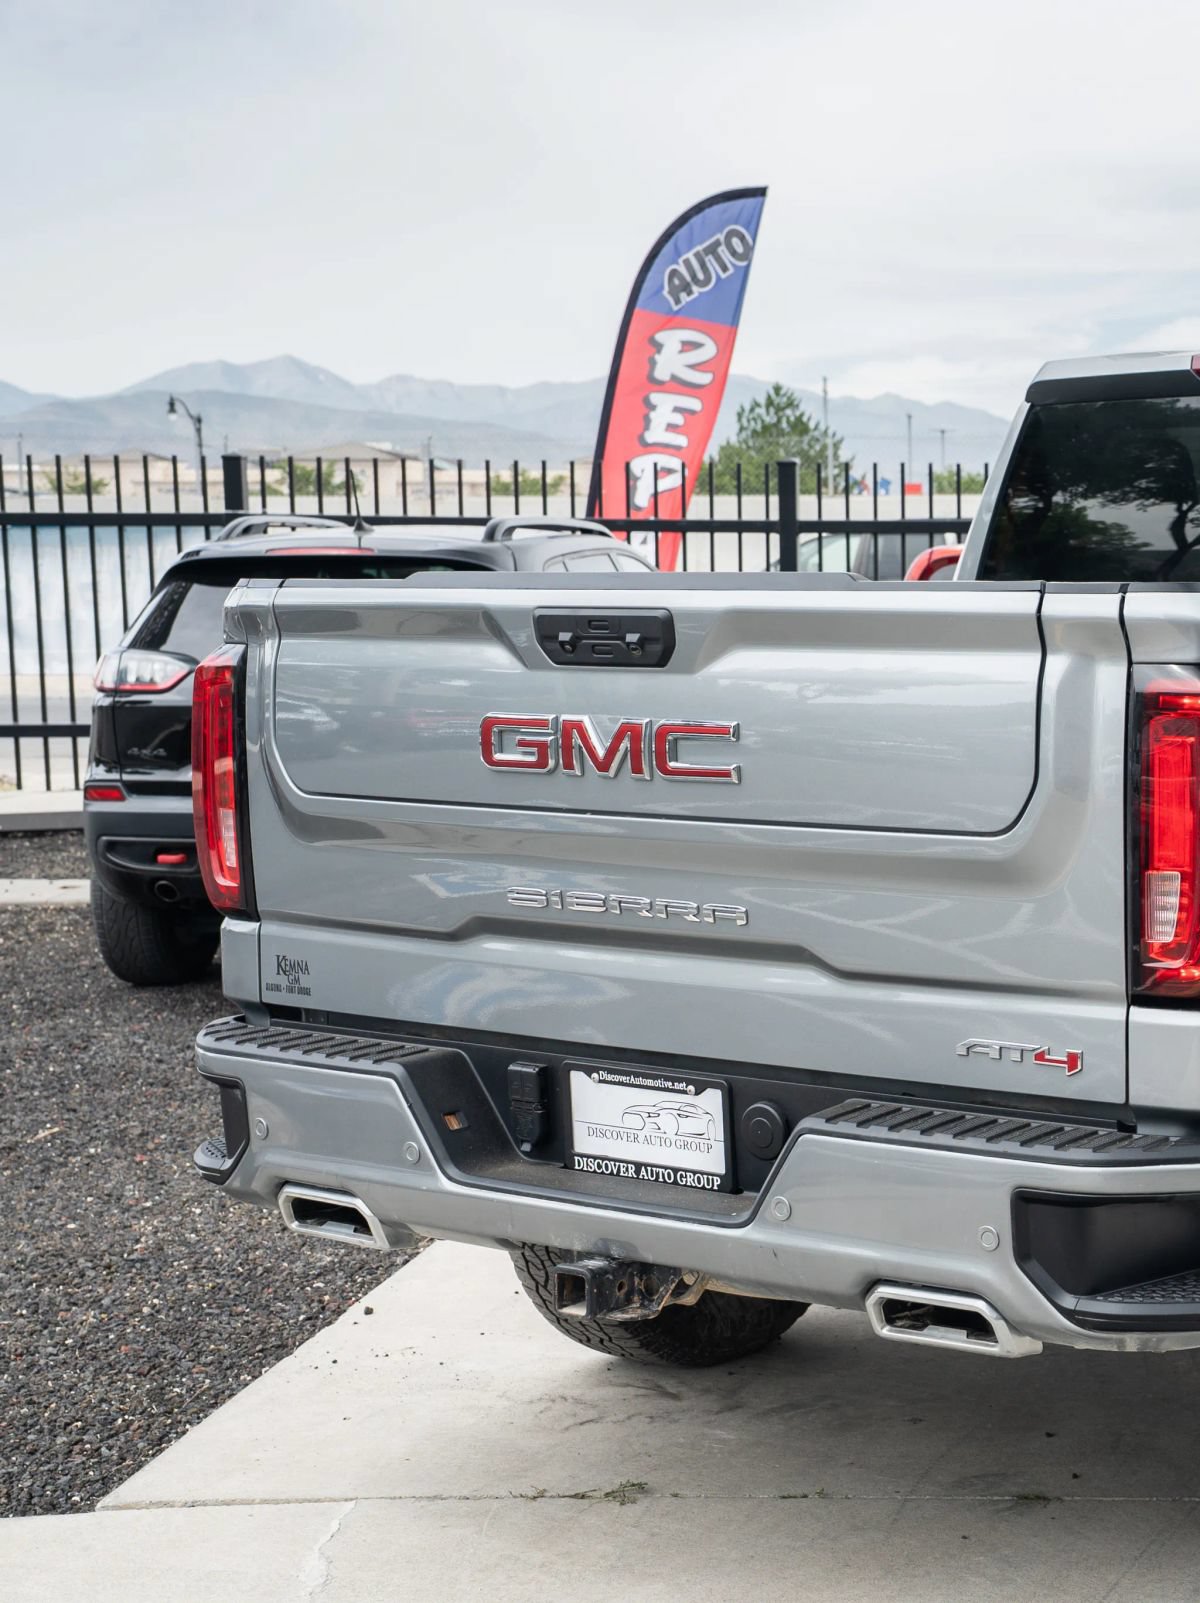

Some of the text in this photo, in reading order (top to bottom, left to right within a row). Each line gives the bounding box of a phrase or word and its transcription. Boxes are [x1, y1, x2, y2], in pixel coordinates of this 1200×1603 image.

[662, 224, 753, 311] AUTO
[480, 712, 742, 784] GMC
[507, 887, 749, 926] SIERRA
[275, 954, 310, 976] KEMNA
[955, 1038, 1083, 1076] AT4
[599, 1070, 687, 1091] DiscoverAutomotive.net
[587, 1126, 713, 1154] DISCOVER AUTO GROUP
[574, 1156, 721, 1190] DISCOVER AUTO GROUP
